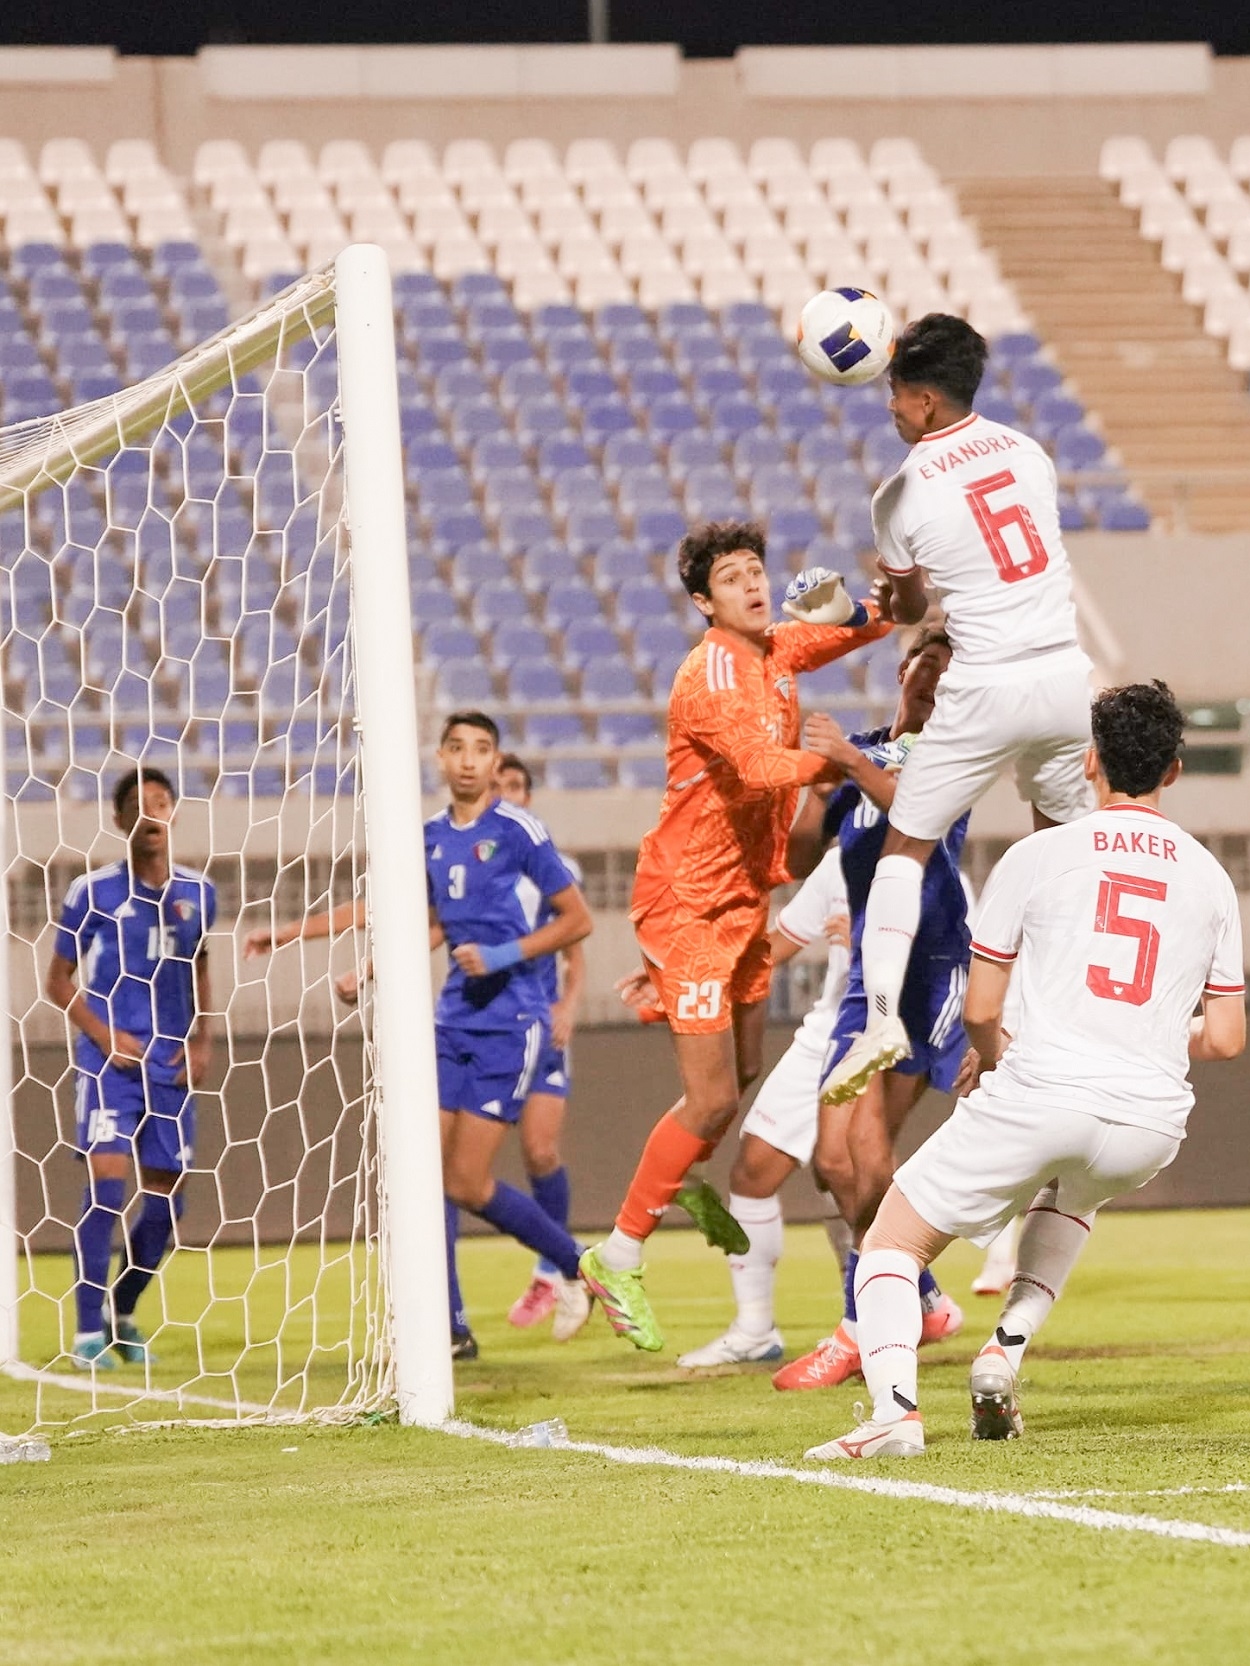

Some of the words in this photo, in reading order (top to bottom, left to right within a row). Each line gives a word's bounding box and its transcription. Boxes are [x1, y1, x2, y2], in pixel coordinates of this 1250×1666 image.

[919, 434, 1019, 480] EVANDRA
[961, 469, 1049, 583] 6
[1093, 830, 1178, 862] BAKER
[448, 864, 466, 899] 3
[1086, 870, 1168, 1006] 5
[677, 980, 721, 1019] 23
